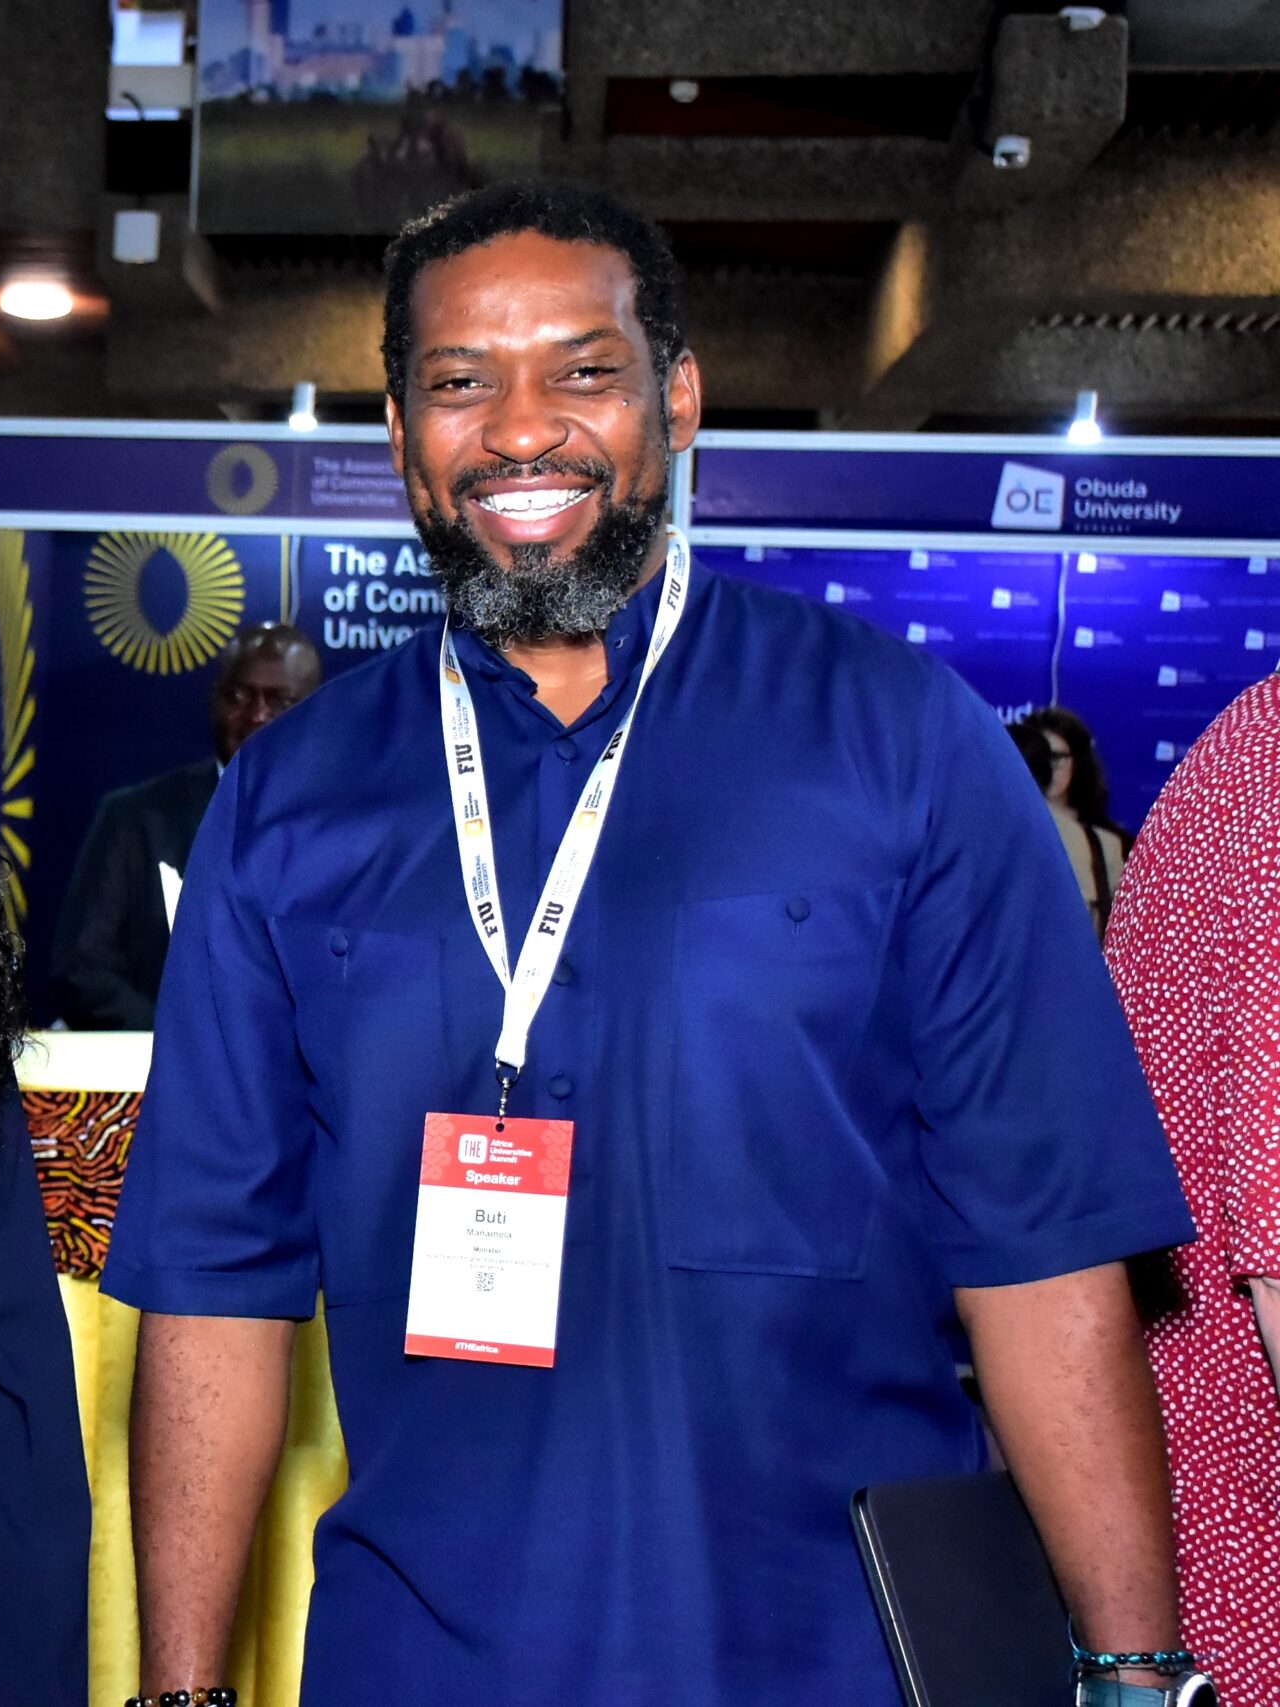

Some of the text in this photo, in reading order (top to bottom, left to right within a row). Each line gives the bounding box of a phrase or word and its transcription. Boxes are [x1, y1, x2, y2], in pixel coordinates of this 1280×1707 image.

[1074, 476, 1148, 499] Obuda
[1073, 499, 1182, 525] University
[323, 543, 387, 577] The
[323, 580, 360, 613] of
[666, 578, 683, 611] FIU
[323, 617, 420, 650] Unive
[454, 743, 475, 775] FIU
[477, 901, 498, 939] FIU
[538, 901, 565, 937] FIU
[464, 1139, 481, 1158] THE
[489, 1147, 533, 1157] Universities
[490, 1139, 513, 1148] Africa
[489, 1155, 518, 1164] Summit
[465, 1169, 521, 1185] Speaker
[475, 1209, 507, 1224] Buti
